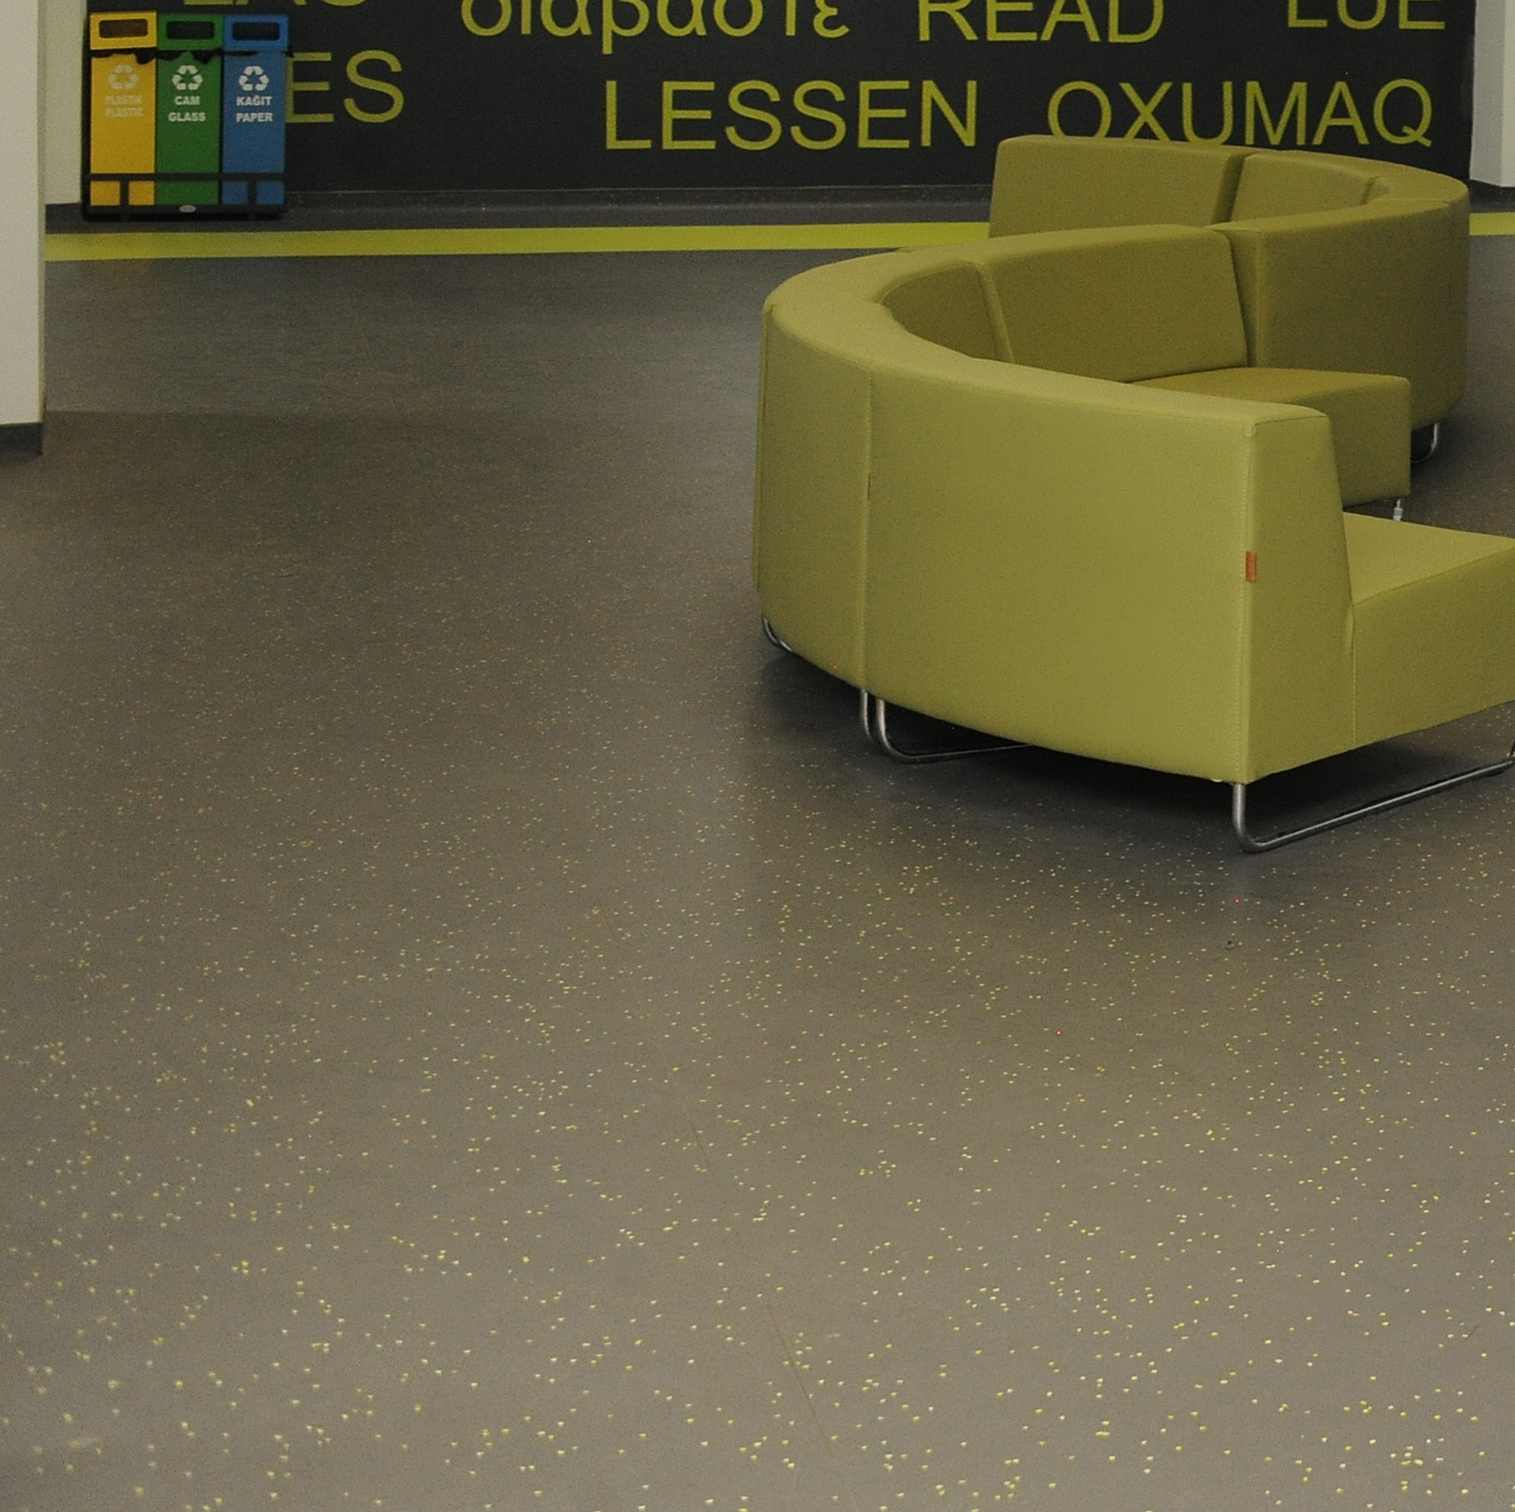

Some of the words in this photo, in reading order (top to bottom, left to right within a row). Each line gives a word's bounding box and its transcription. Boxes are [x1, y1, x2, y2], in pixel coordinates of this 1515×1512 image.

[174, 94, 200, 106] CAM
[236, 94, 273, 106] KAĞIT
[168, 111, 206, 123] GLASS
[236, 112, 273, 124] PAPER
[606, 80, 977, 150] LESSEN
[1047, 78, 1433, 147] OXUMAQ
